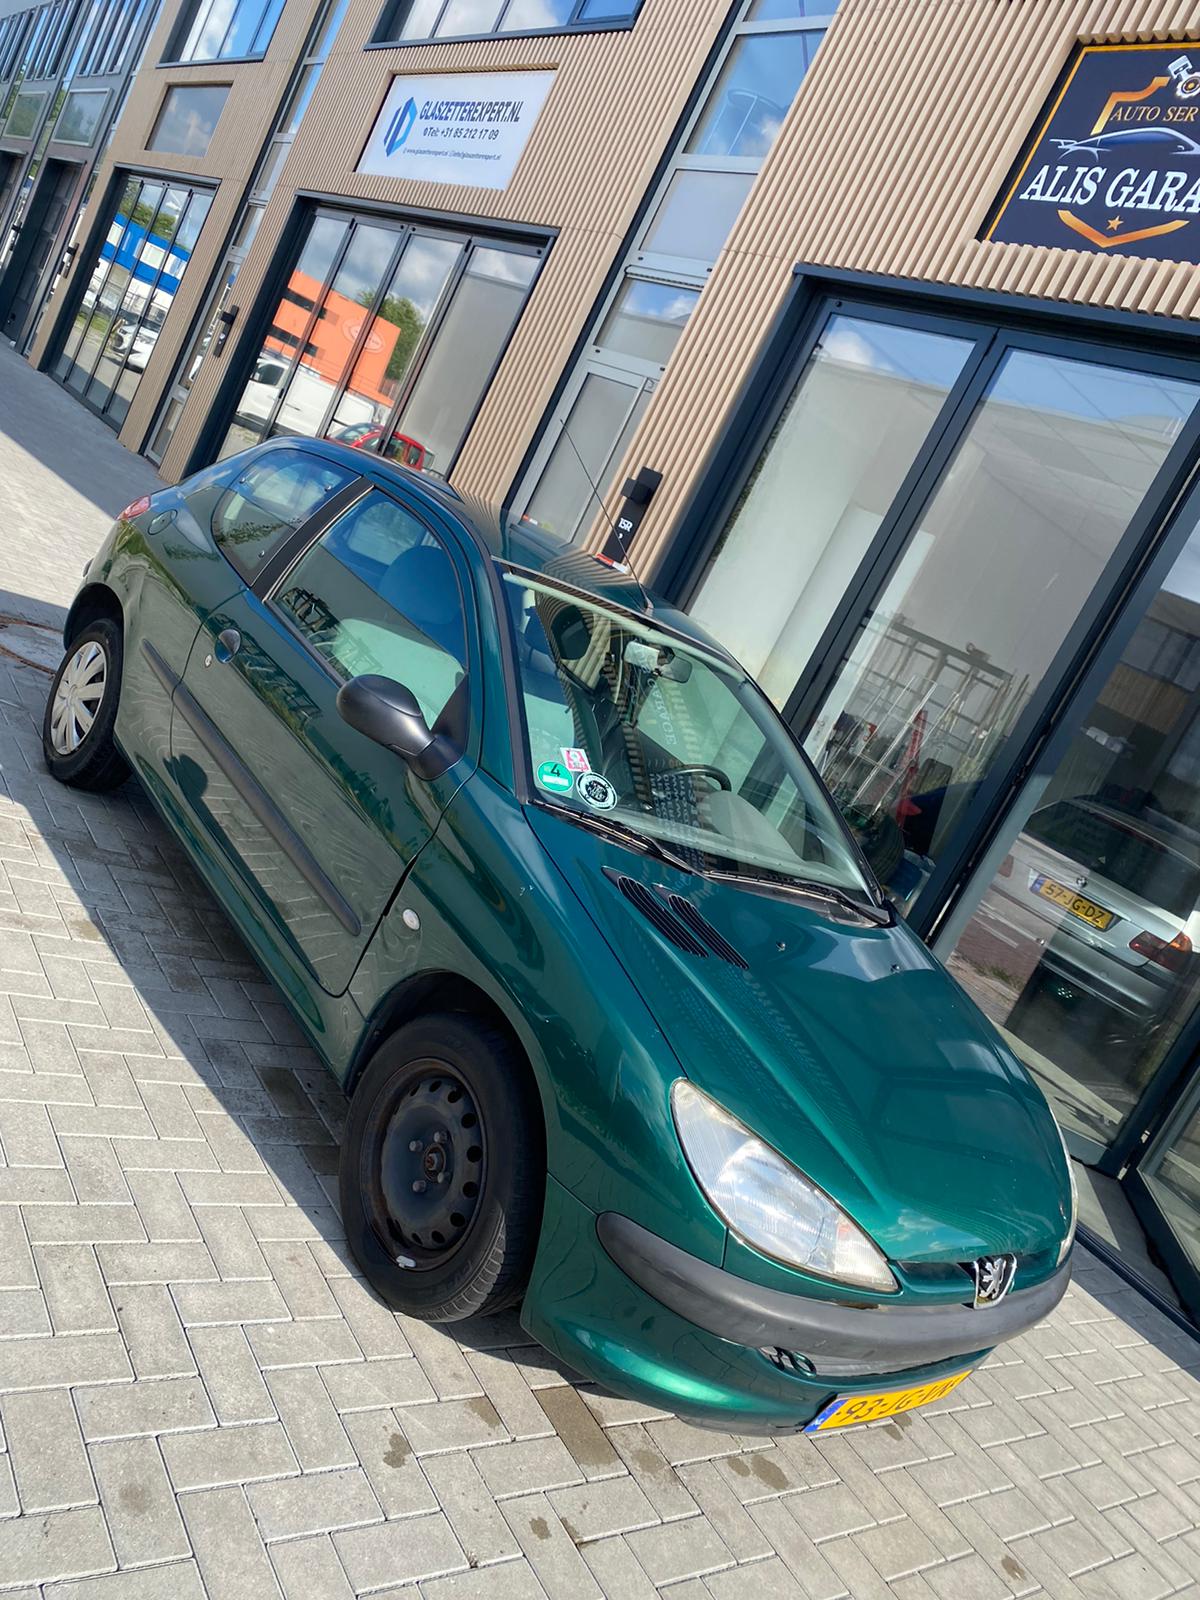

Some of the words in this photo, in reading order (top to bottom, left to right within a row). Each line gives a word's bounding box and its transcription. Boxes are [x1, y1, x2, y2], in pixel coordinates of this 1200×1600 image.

[419, 100, 524, 122] GLASZETTEREXPERT.NL
[1110, 105, 1161, 122] AUTO
[441, 127, 453, 138] +31
[463, 128, 478, 139] 212
[479, 128, 489, 140] 17
[1019, 165, 1106, 205] ALIS
[550, 763, 561, 777] 4
[1045, 883, 1106, 923] 57-JG-DZ
